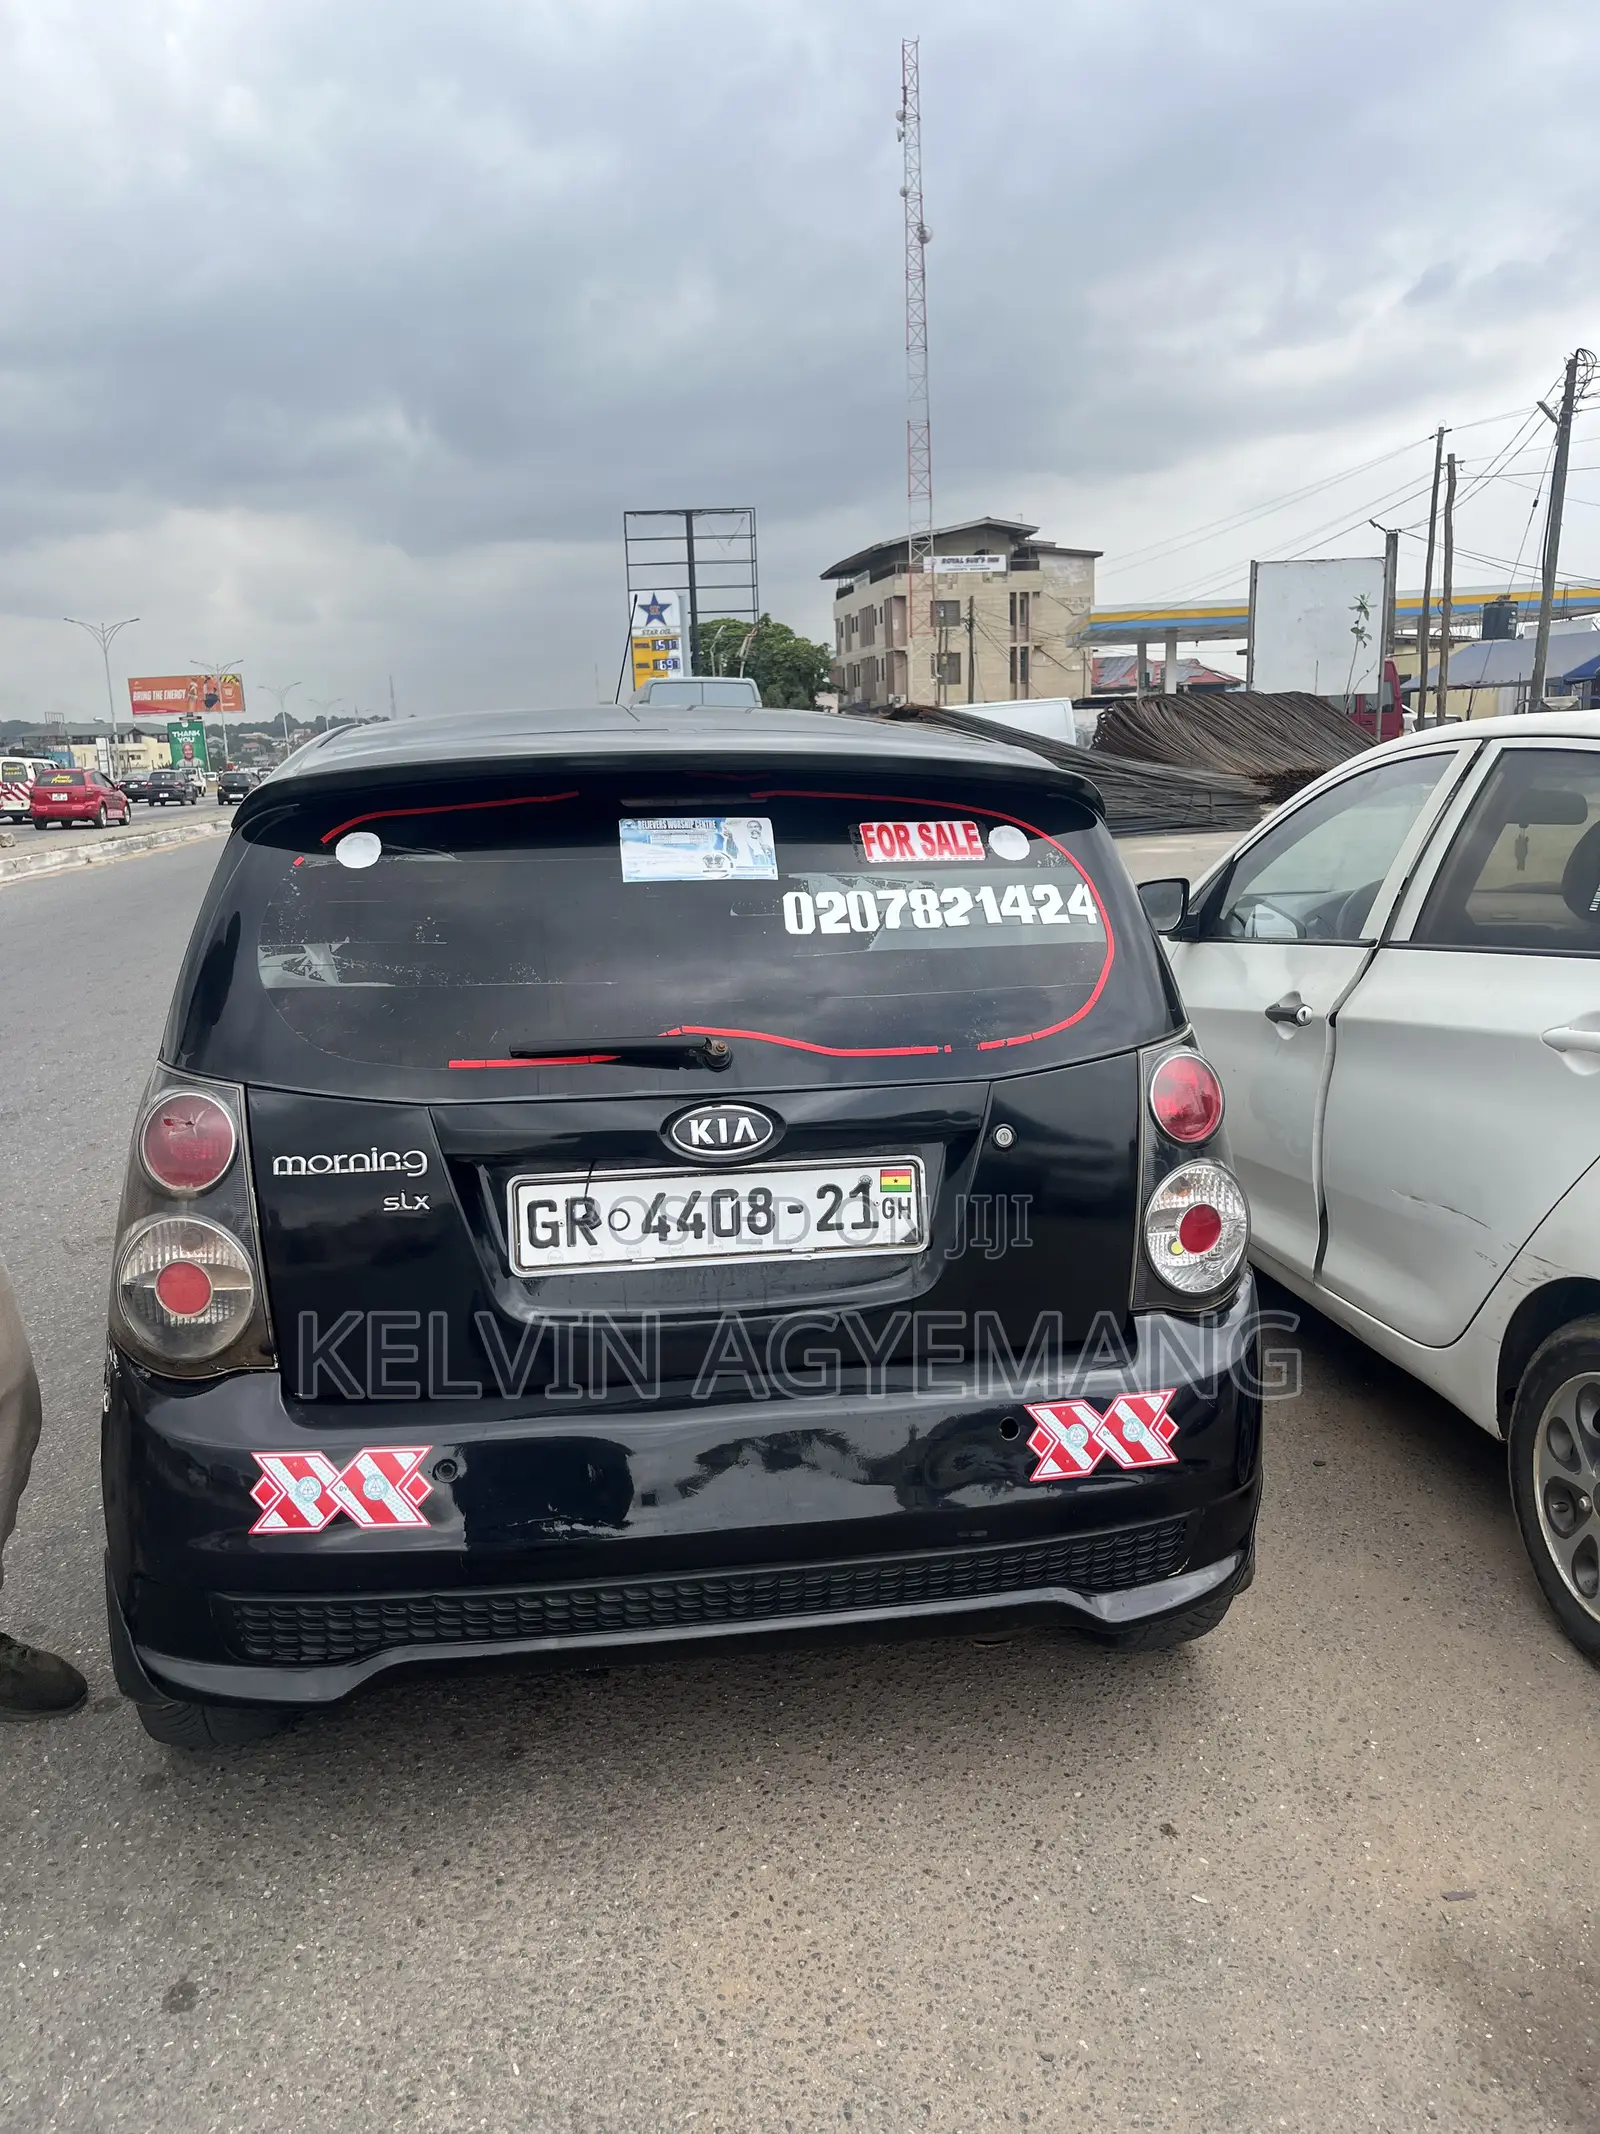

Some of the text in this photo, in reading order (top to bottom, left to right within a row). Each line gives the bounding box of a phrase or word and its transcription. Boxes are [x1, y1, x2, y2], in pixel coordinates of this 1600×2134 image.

[152, 690, 163, 700] THE
[163, 689, 186, 700] ENERGY
[172, 730, 200, 738] THANK
[667, 820, 695, 830] WORSHIP
[859, 821, 984, 858] FOR SALE
[782, 884, 1098, 935] 0207821424
[690, 1118, 761, 1145] KIA
[272, 1146, 428, 1177] morning
[881, 1196, 912, 1220] GH
[526, 1195, 598, 1249] GR
